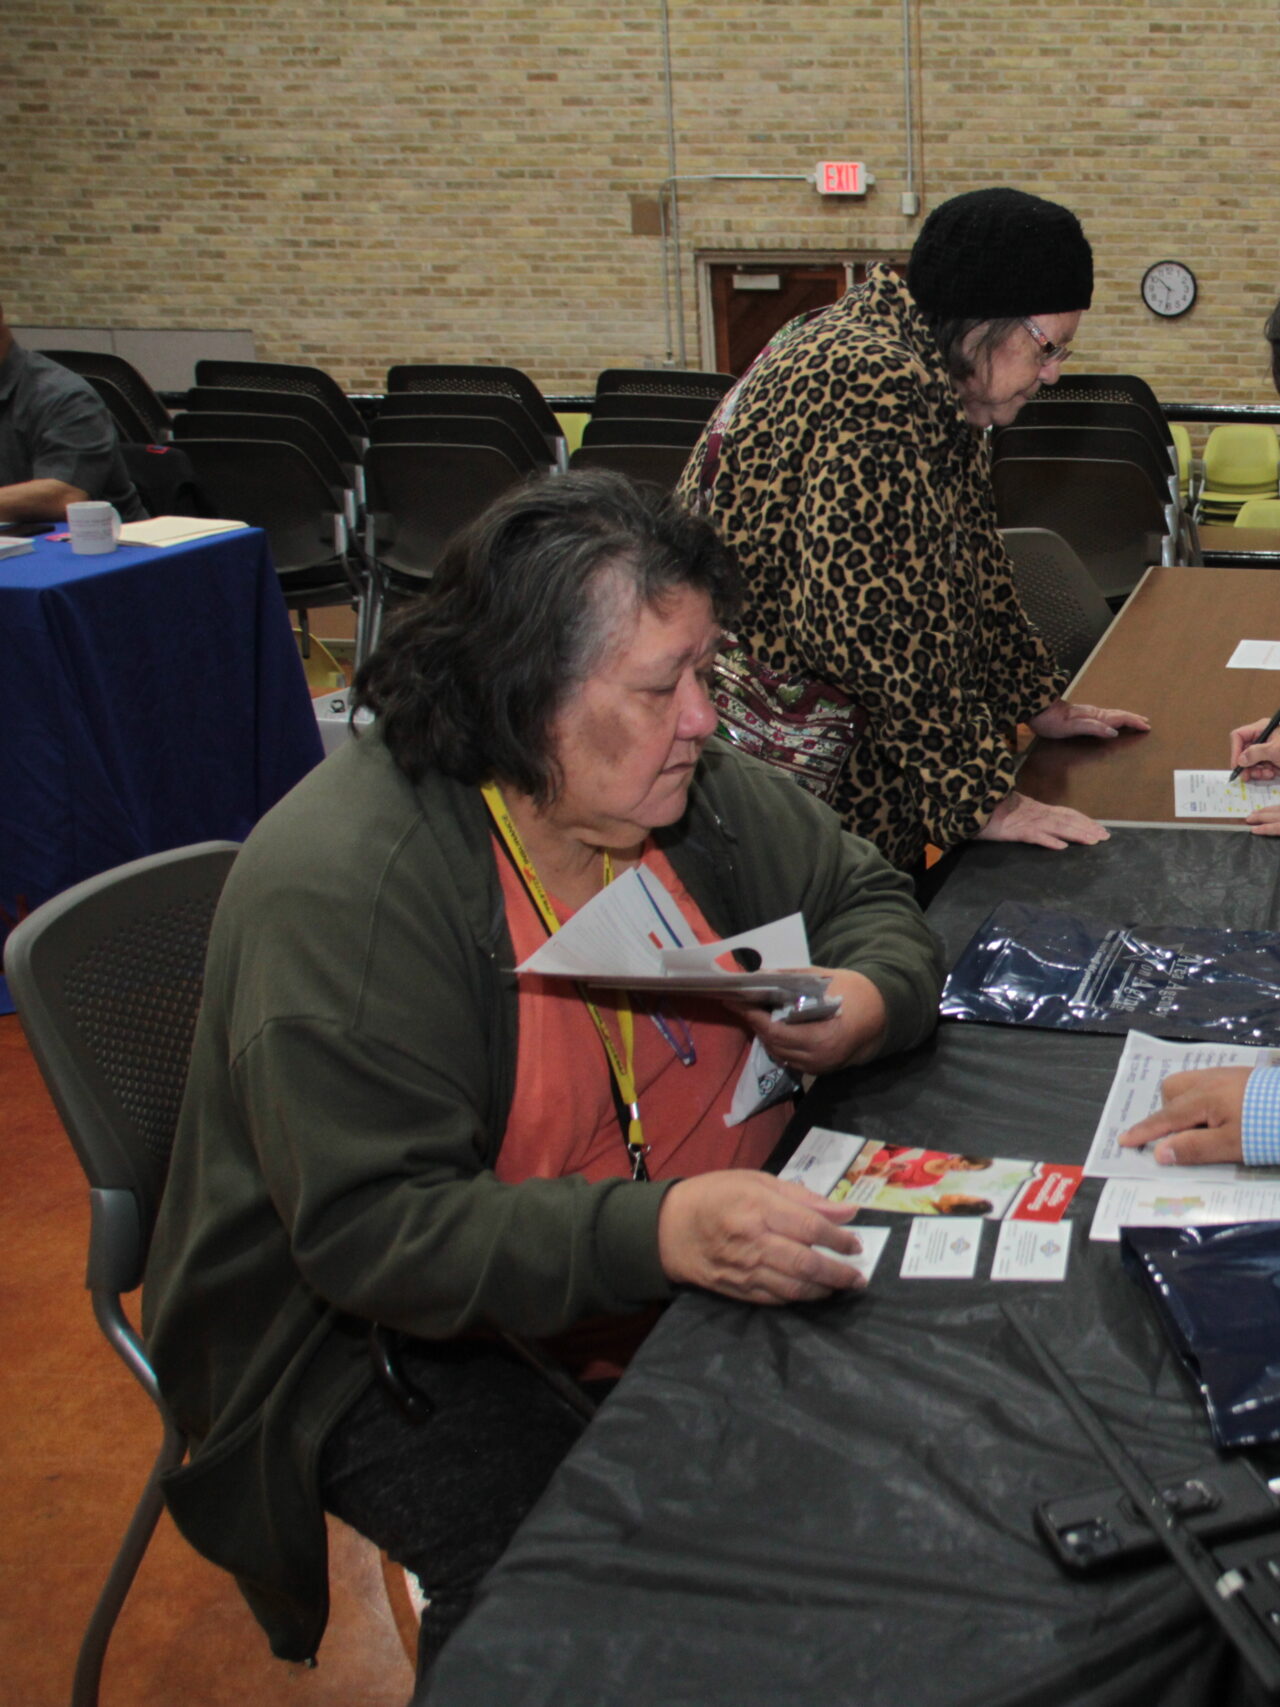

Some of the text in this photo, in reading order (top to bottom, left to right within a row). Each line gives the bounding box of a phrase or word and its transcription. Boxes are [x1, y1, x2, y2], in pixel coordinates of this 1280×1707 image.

[824, 164, 859, 192] EXIT
[1172, 954, 1204, 980] Area
[1117, 963, 1156, 1013] on Aging
